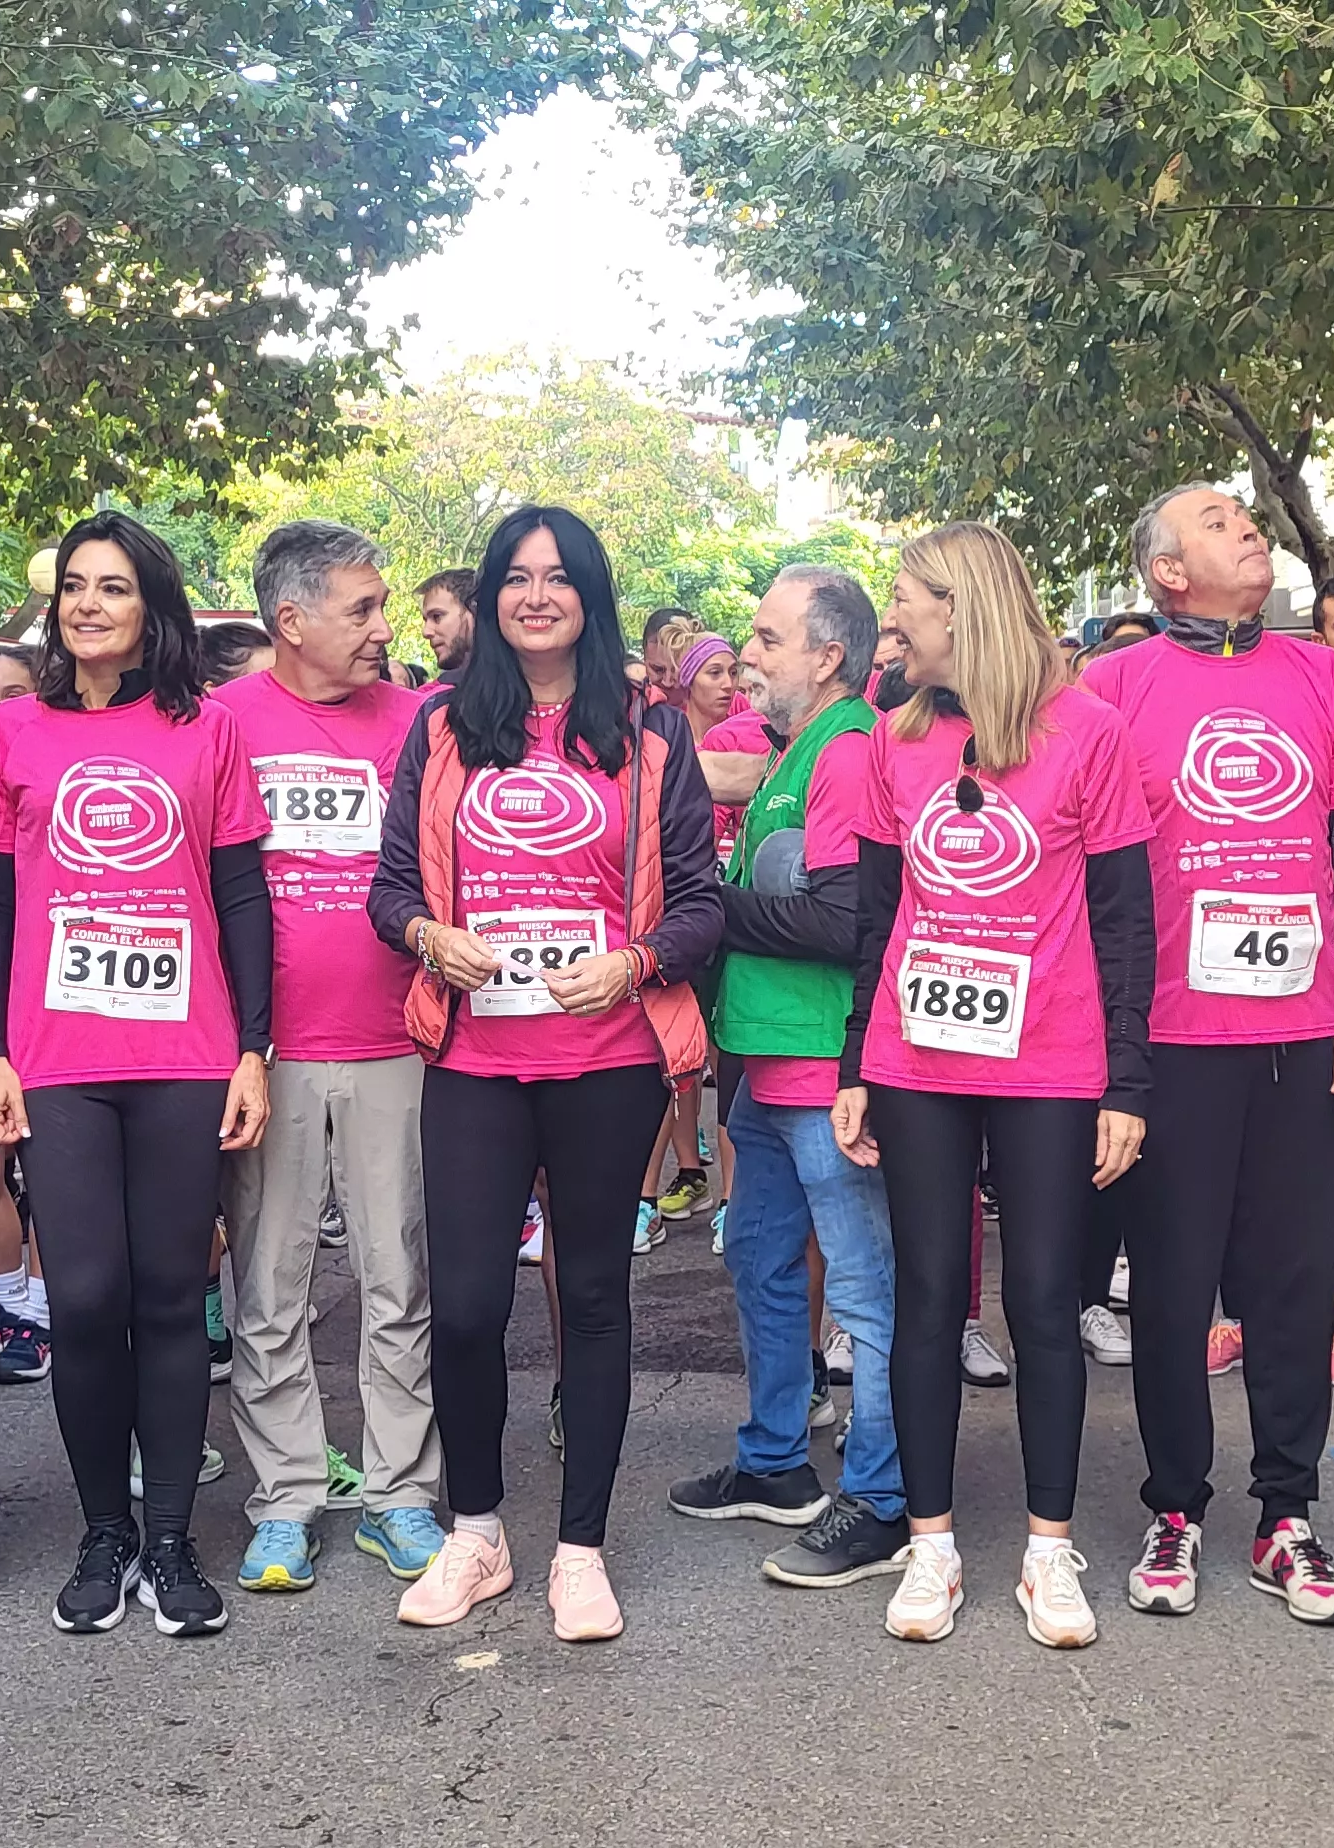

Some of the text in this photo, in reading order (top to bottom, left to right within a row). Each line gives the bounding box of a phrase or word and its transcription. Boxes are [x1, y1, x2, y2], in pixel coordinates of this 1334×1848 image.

[258, 772, 304, 783] CONTRA
[306, 774, 319, 782] EL
[262, 786, 366, 821] 1887
[518, 922, 553, 931] HUESCA
[1208, 911, 1258, 925] CONTRA
[1259, 914, 1273, 925] EL
[71, 928, 178, 948] CONTRA EL CÁNCER
[110, 924, 143, 936] HUESCA
[482, 928, 592, 943] CONTRA EL CÁNCER
[1233, 930, 1290, 967] 46
[63, 944, 177, 990] 3109
[912, 960, 1012, 984] CONTRA EL CÁNCER
[907, 976, 1010, 1025] 1889
